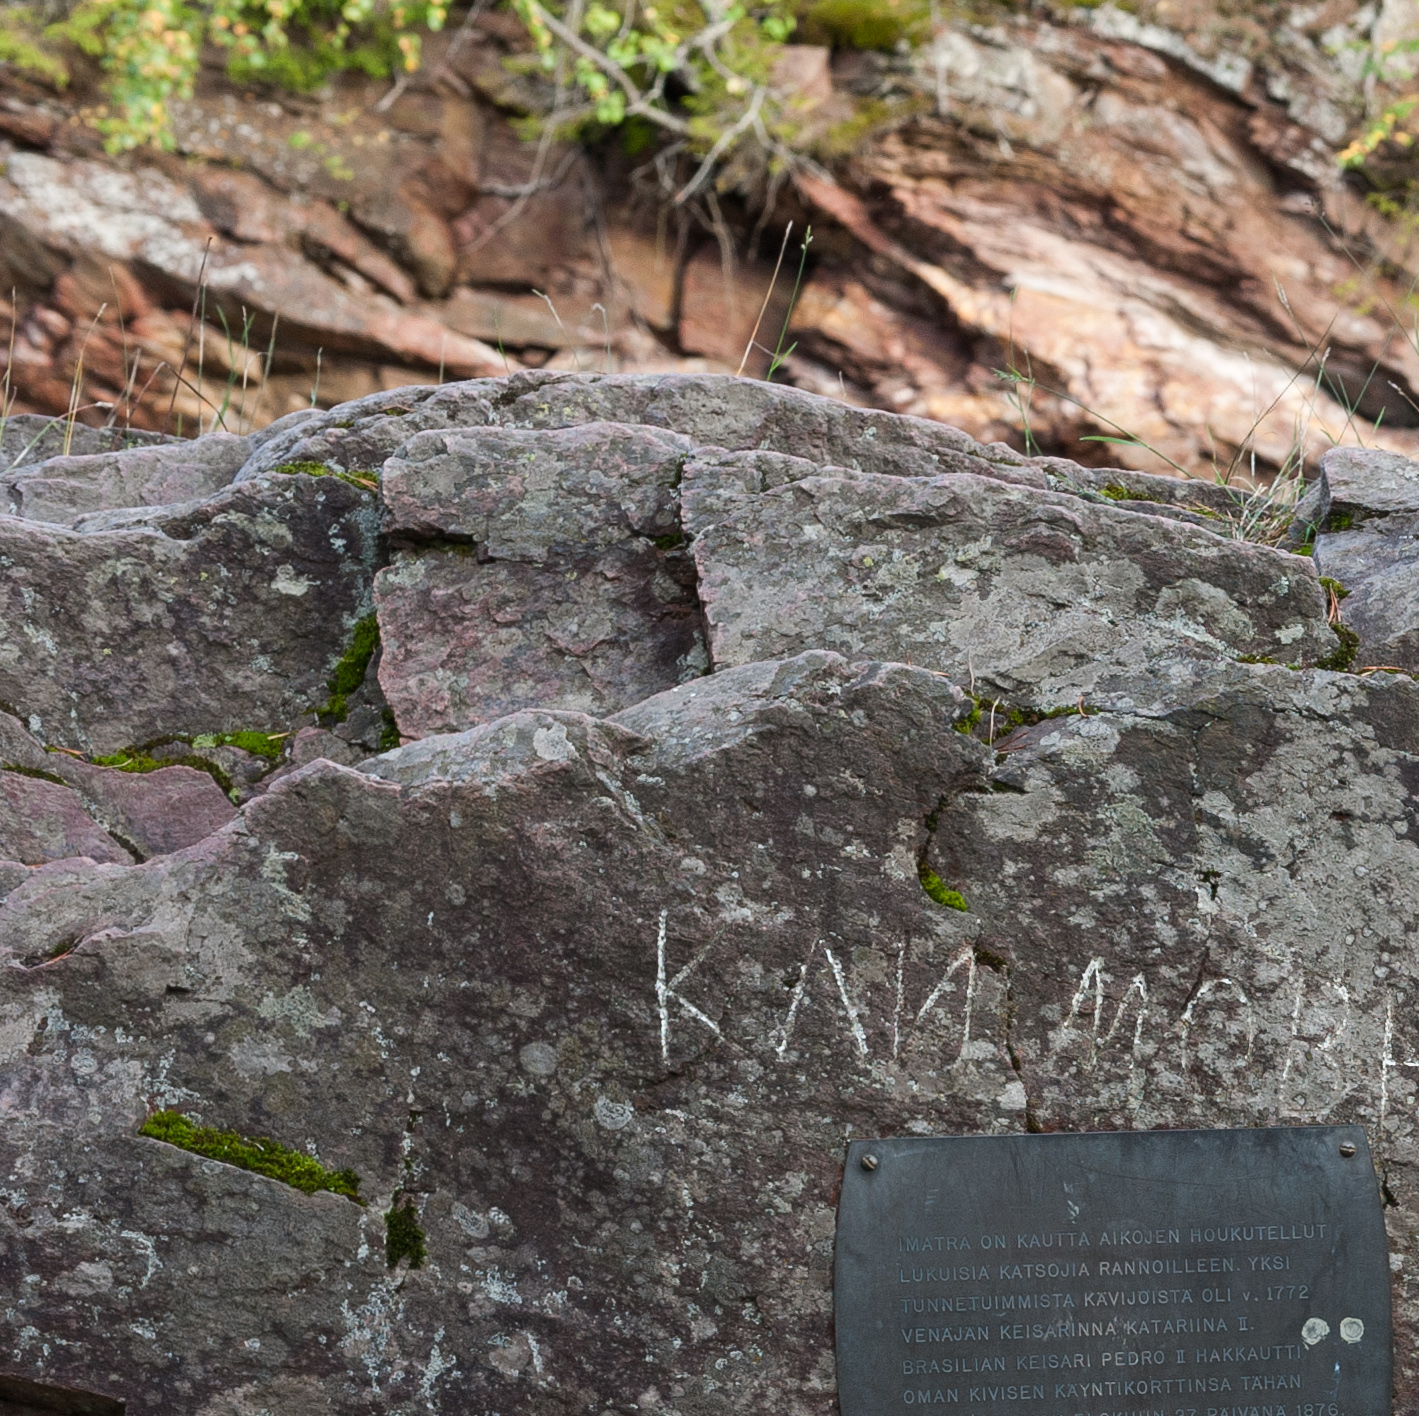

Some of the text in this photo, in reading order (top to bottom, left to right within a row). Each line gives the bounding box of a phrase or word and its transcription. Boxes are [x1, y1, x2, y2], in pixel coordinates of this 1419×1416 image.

[899, 1223, 1328, 1253] IMATRA ON KAUTTA AIKOJEN HOUKUTELLUT
[899, 1255, 1292, 1284] LUKUISIA KATSOJIA RANNOILLEEN. YKSI
[901, 1284, 1310, 1314] TUNNETUIMMISTA KÄVIJÖISTÄ OLI v. 1772
[902, 1323, 991, 1345] VENÄJÄN
[1000, 1321, 1117, 1340] KEISARINNA
[1126, 1316, 1229, 1336] KATARIINA
[902, 1356, 1006, 1375] BRASILIAN
[1016, 1353, 1092, 1371] KEISARI
[1101, 1350, 1165, 1367] PEDRO
[1196, 1344, 1301, 1363] HAKKAUTTI
[902, 1371, 1302, 1405] OMAN KIVISEN KÄYNTIKORTTINSA TÄHÄN
